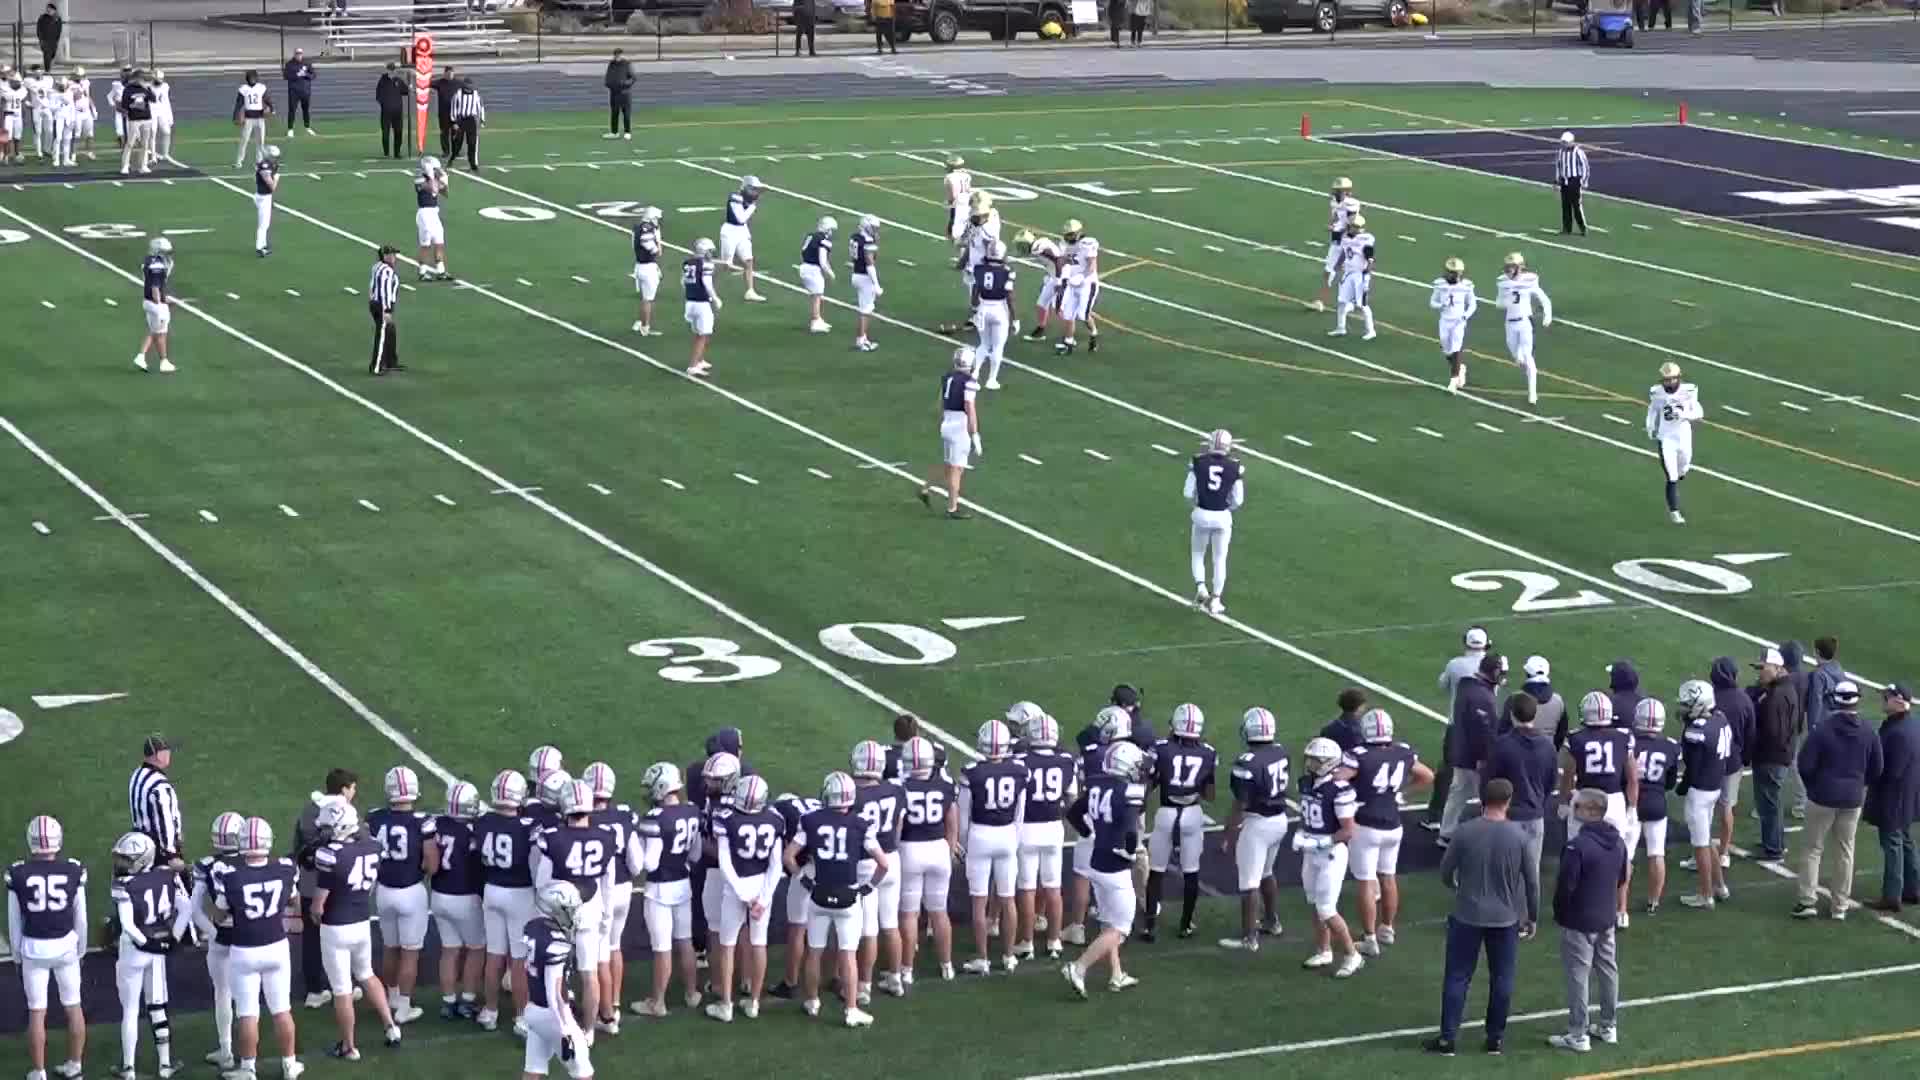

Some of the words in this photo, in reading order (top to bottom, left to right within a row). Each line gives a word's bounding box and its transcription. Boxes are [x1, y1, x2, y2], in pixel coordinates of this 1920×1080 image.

[983, 272, 994, 290] 8
[1512, 291, 1521, 304] 3
[1208, 465, 1223, 491] 5
[1171, 755, 1203, 787] 17
[1584, 740, 1616, 773] 21
[984, 776, 1016, 810] 18
[1032, 767, 1062, 801] 19
[1267, 758, 1290, 797] 75
[1372, 760, 1406, 795] 44
[862, 797, 897, 834] 97
[906, 791, 945, 825] 56
[1088, 786, 1114, 823] 84
[482, 832, 513, 868] 49
[565, 840, 603, 876] 42
[737, 824, 776, 859] 33
[817, 825, 848, 860] 31
[347, 853, 380, 891] 45
[26, 875, 68, 912] 35
[143, 884, 173, 925] 14
[242, 879, 284, 919] 57
